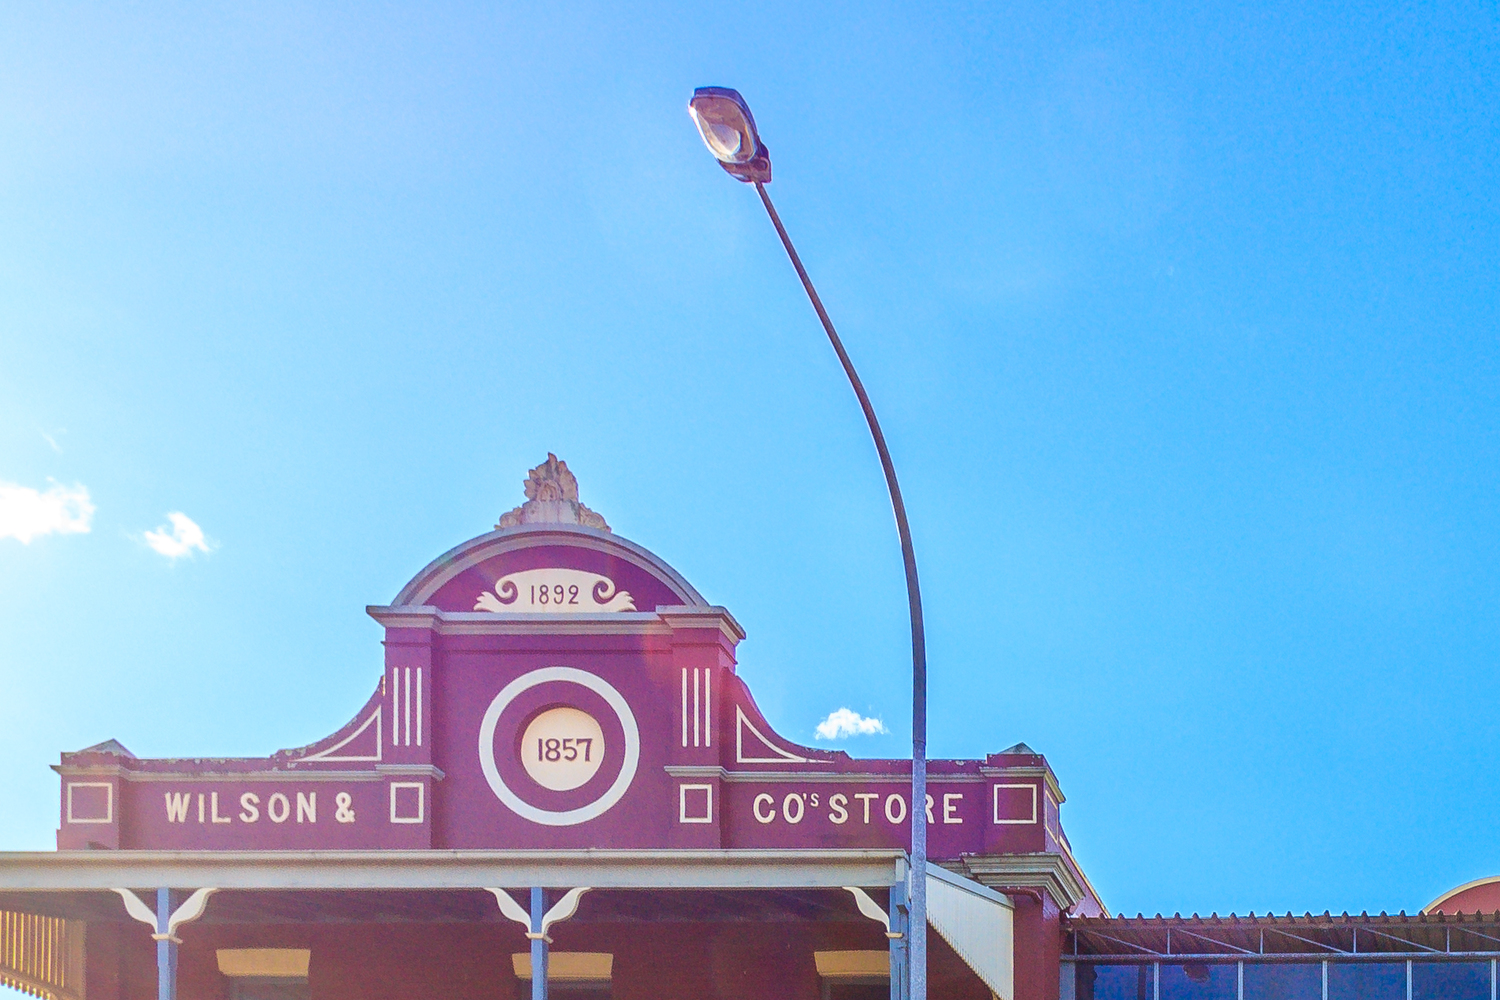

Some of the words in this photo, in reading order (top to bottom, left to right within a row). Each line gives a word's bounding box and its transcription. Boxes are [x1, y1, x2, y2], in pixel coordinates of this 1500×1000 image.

[531, 585, 579, 604] 1892
[538, 738, 593, 762] 1857
[165, 792, 316, 823] WILSON
[335, 792, 355, 823] &
